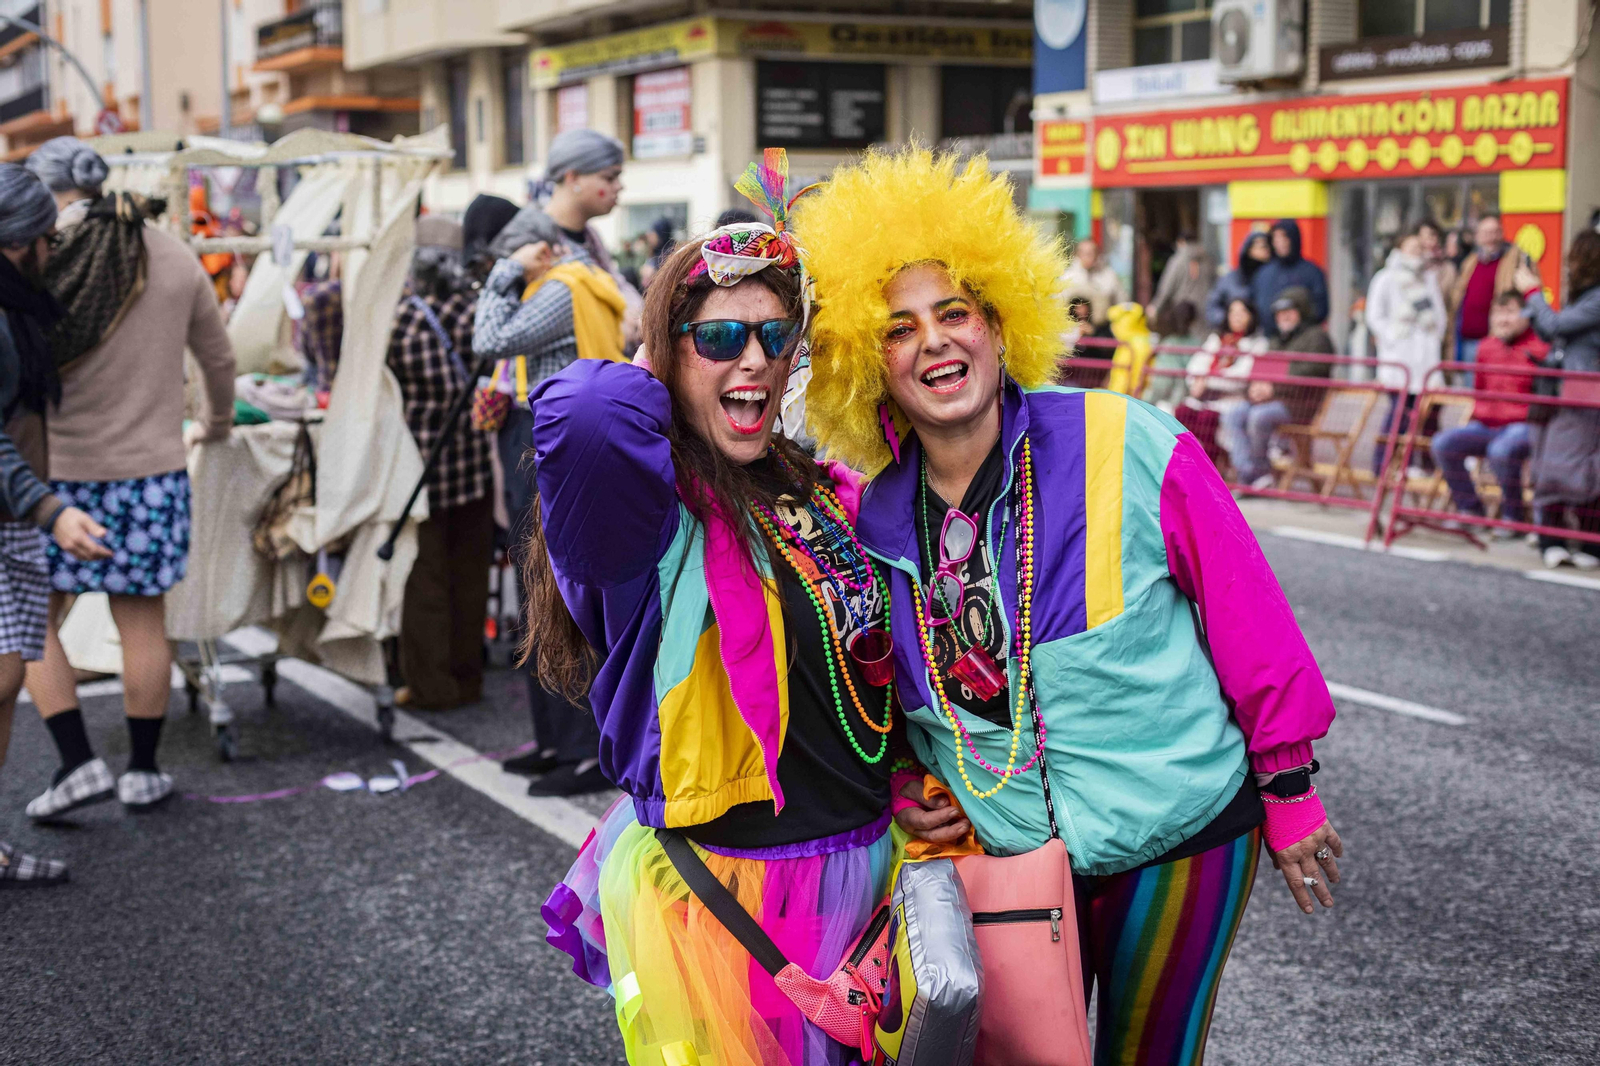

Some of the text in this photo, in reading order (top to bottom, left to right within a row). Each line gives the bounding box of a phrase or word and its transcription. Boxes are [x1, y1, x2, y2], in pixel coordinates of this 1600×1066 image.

[1123, 123, 1167, 161] XIN
[1171, 113, 1261, 158] WANG
[1271, 90, 1560, 143] ALIMENTACIÓN BAZAR
